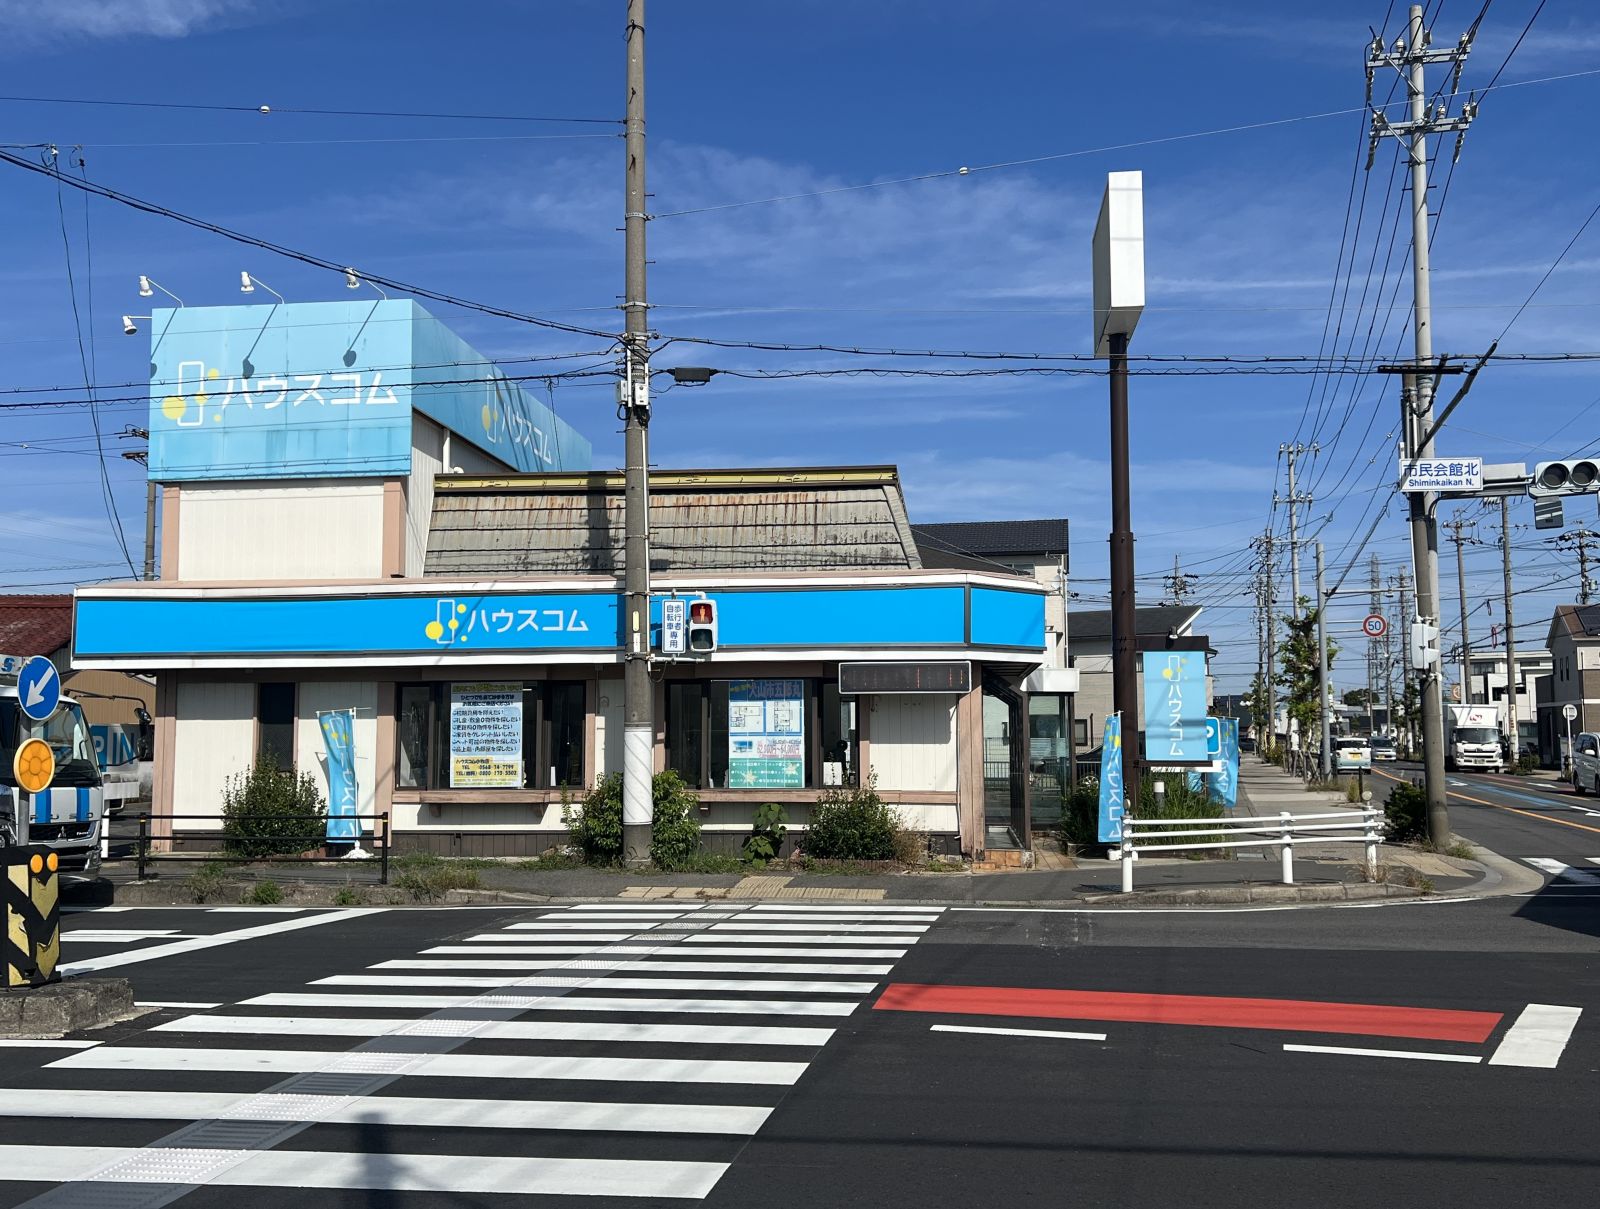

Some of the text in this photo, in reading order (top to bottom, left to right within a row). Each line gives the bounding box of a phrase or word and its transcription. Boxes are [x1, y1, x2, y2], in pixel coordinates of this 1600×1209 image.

[221, 371, 399, 410] ハウスコム
[502, 402, 552, 465] ハウスコム
[1403, 462, 1479, 477] 市民会館北
[1408, 478, 1463, 487] Shiminkaikan
[467, 608, 589, 633] ハウスコム
[666, 604, 674, 630] 自転車
[674, 604, 682, 630] 歩行者
[1367, 620, 1382, 631] 50
[1168, 684, 1183, 756] ハウスコム
